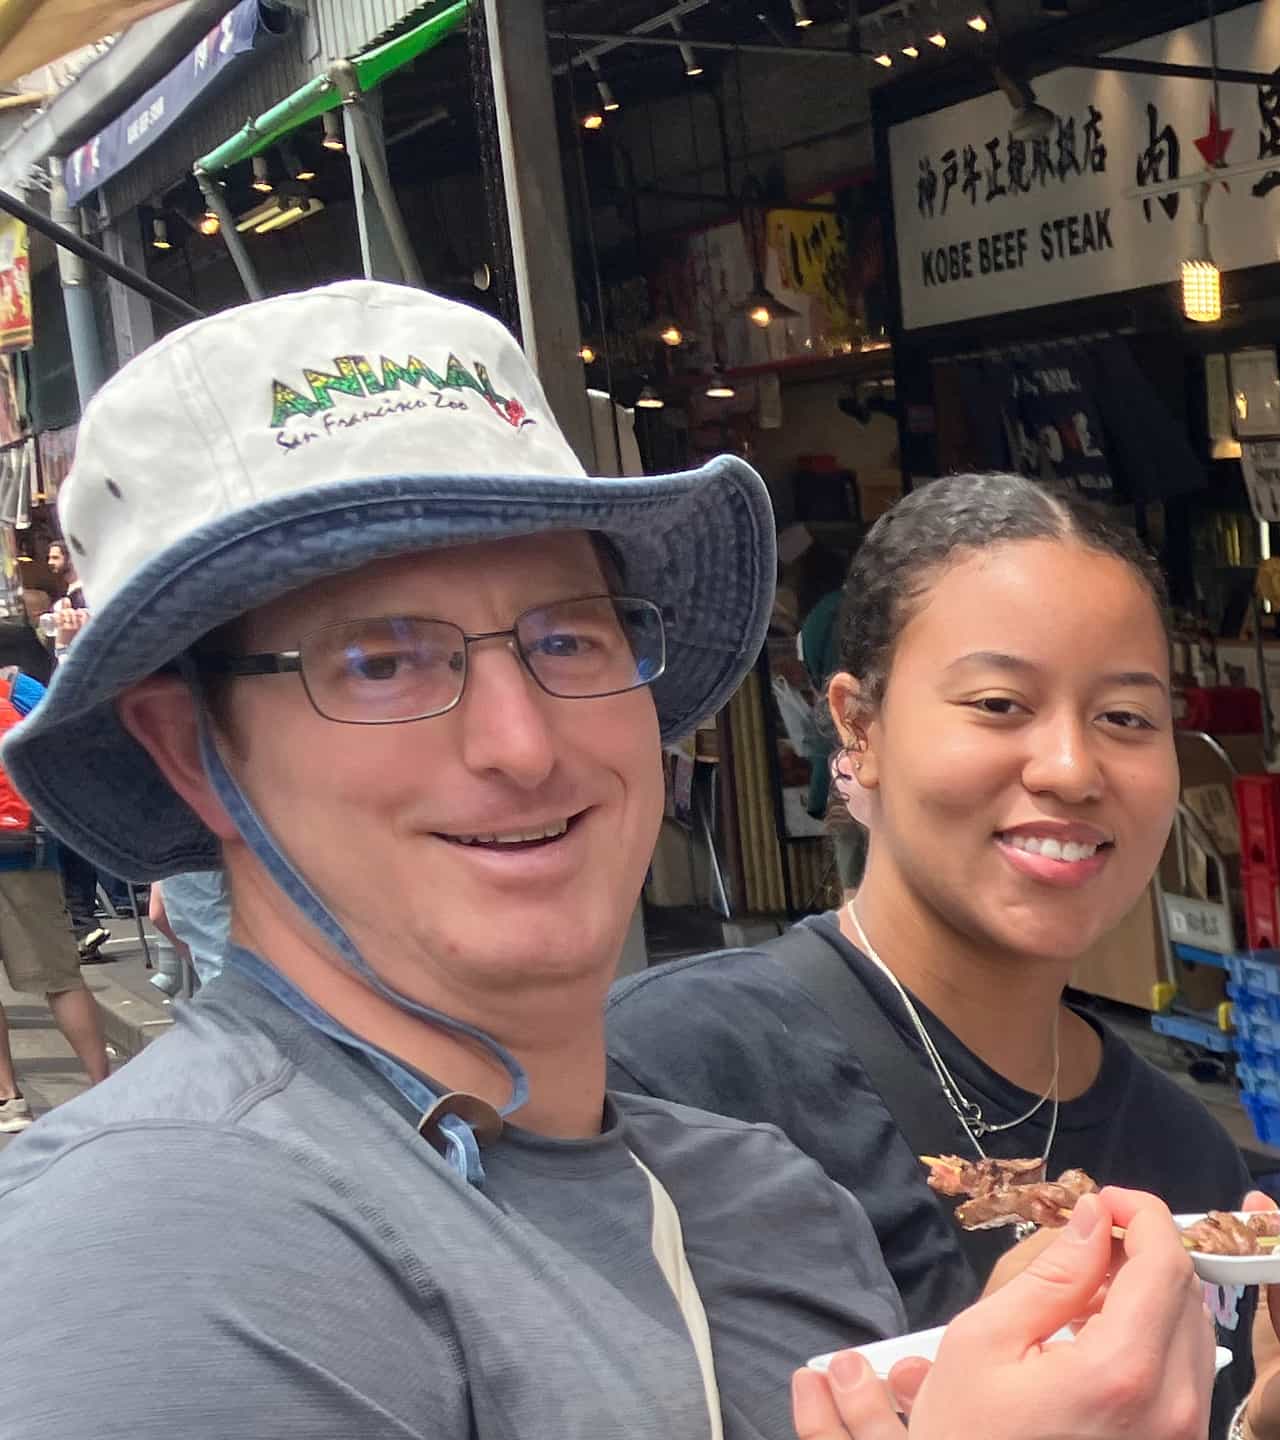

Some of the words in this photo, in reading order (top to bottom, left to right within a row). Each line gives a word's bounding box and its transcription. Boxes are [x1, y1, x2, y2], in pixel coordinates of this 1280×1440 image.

[921, 243, 973, 287] KOBE
[979, 227, 1029, 276] BEEF
[1040, 207, 1114, 263] STEAK
[322, 397, 426, 435] Francisco
[428, 391, 471, 411] Zoo
